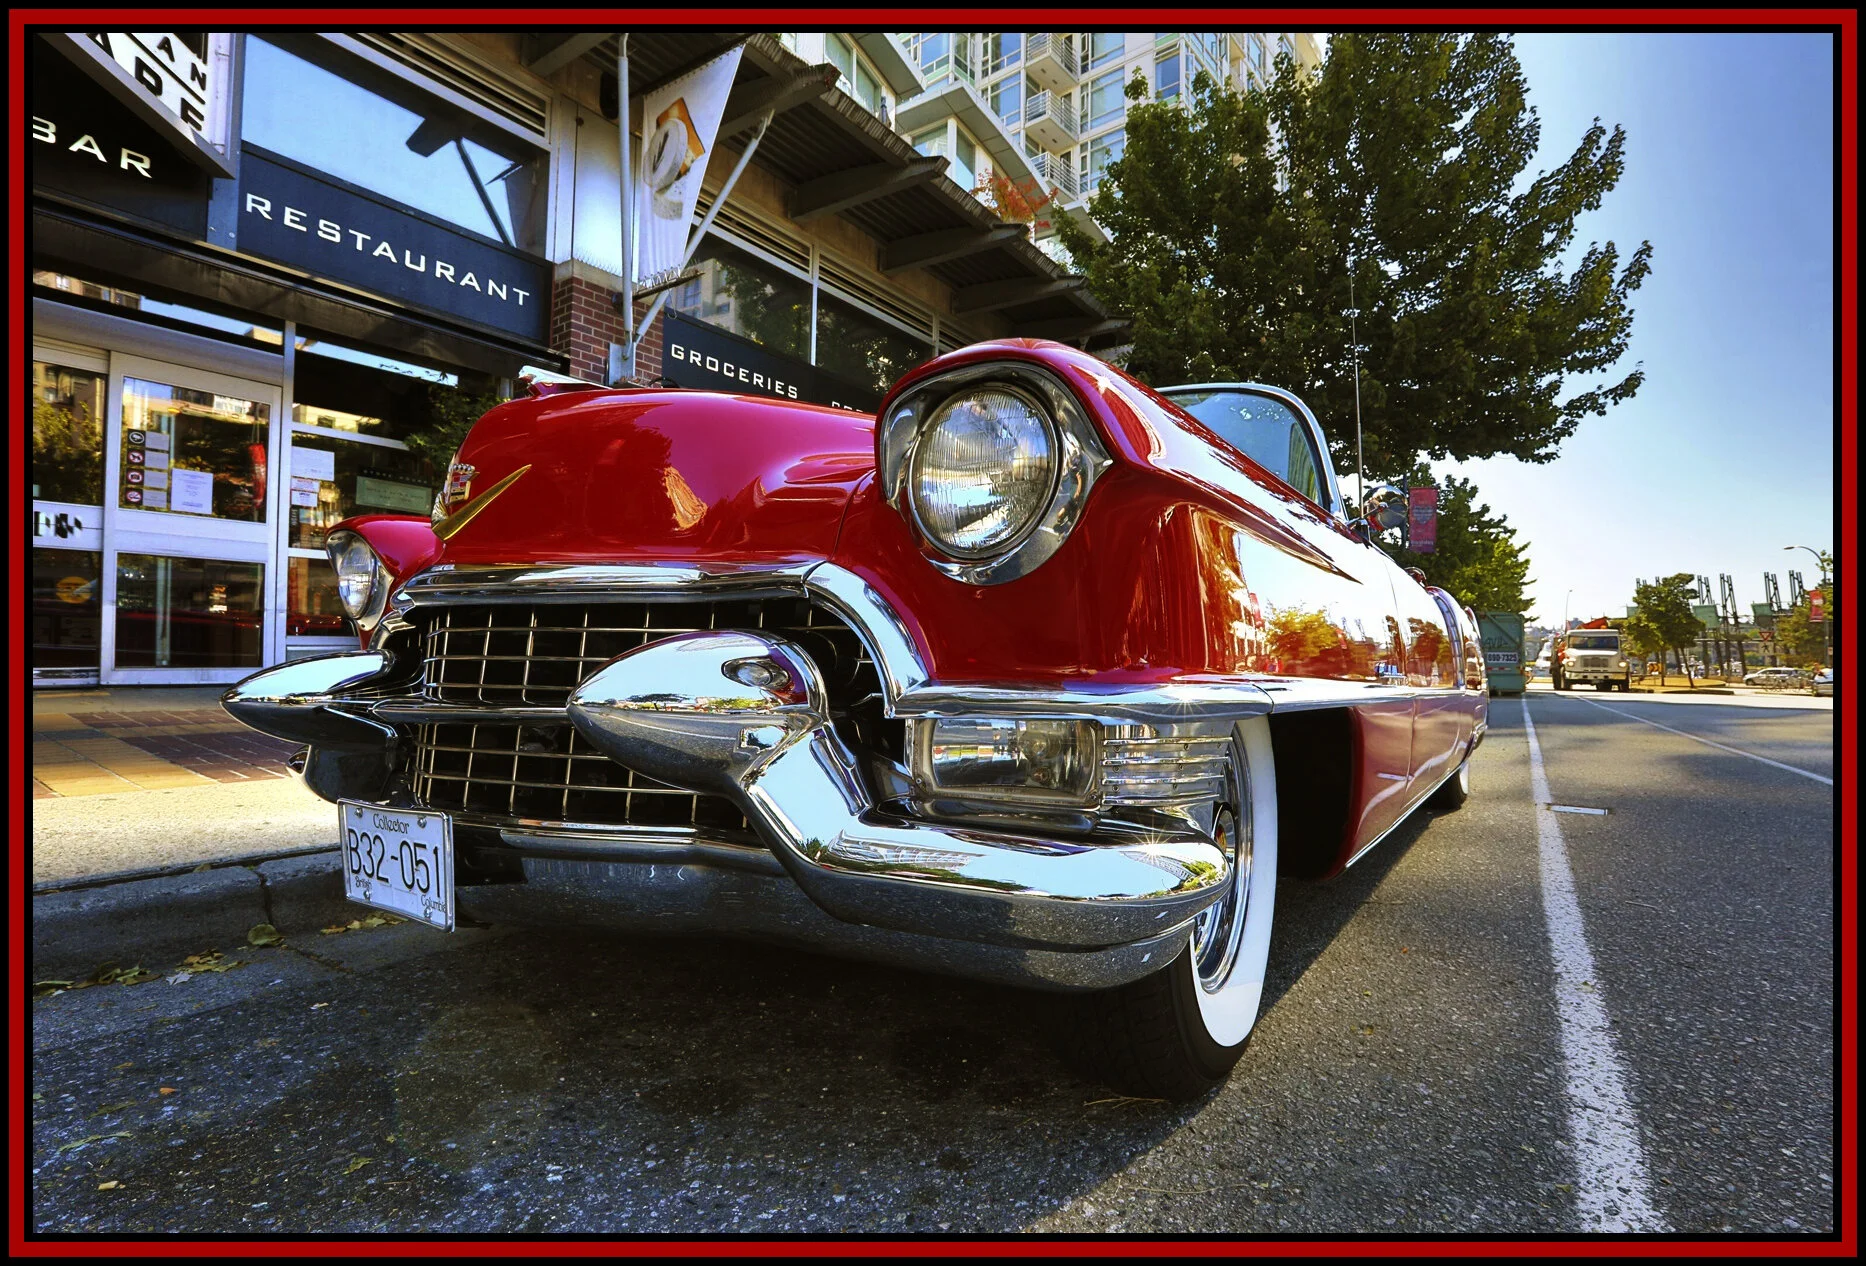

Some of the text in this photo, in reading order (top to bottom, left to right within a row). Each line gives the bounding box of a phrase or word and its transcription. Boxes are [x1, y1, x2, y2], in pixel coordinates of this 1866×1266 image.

[33, 116, 152, 178] BAR
[246, 193, 529, 306] RESTAURANT
[671, 344, 797, 399] GROCERIES
[373, 813, 410, 834] Collector
[348, 828, 440, 898] B32-051
